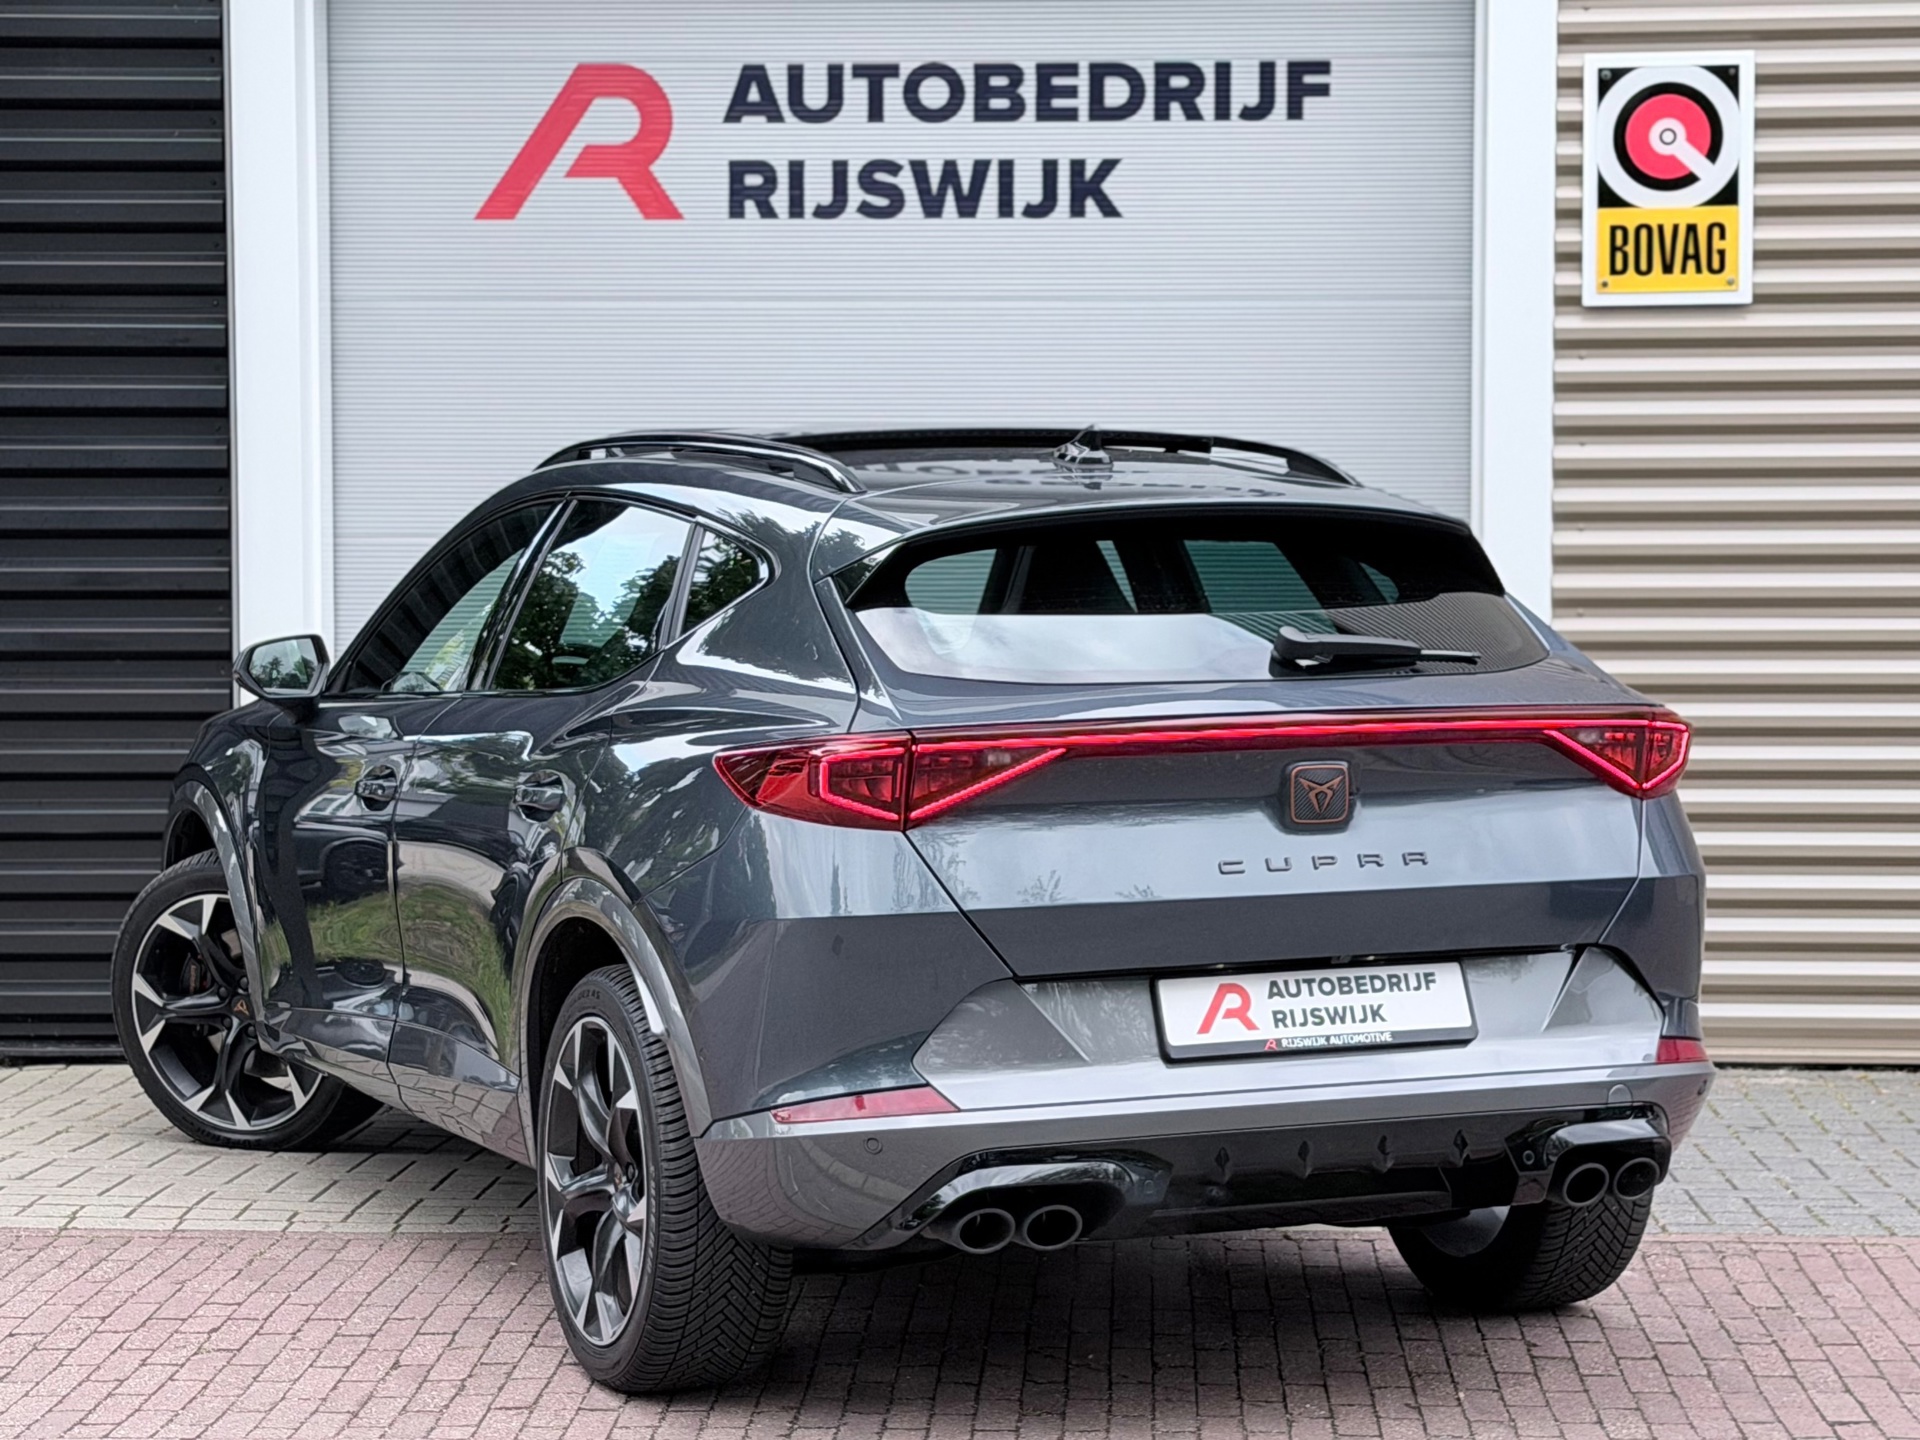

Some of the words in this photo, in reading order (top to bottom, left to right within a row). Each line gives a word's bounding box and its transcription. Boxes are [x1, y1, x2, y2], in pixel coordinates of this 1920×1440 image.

[724, 60, 1331, 123] AUTOBEDRIJF
[729, 159, 1122, 219] RIJSWIJK
[1609, 222, 1726, 276] BOVAG
[1218, 852, 1429, 875] CUPRA
[1267, 972, 1437, 1000] AUTOBEDRIJF
[1271, 1004, 1387, 1029] RIJSWIJK
[1281, 1036, 1327, 1048] RIJSWIJK
[1329, 1031, 1393, 1045] AUTOMOTIVE
